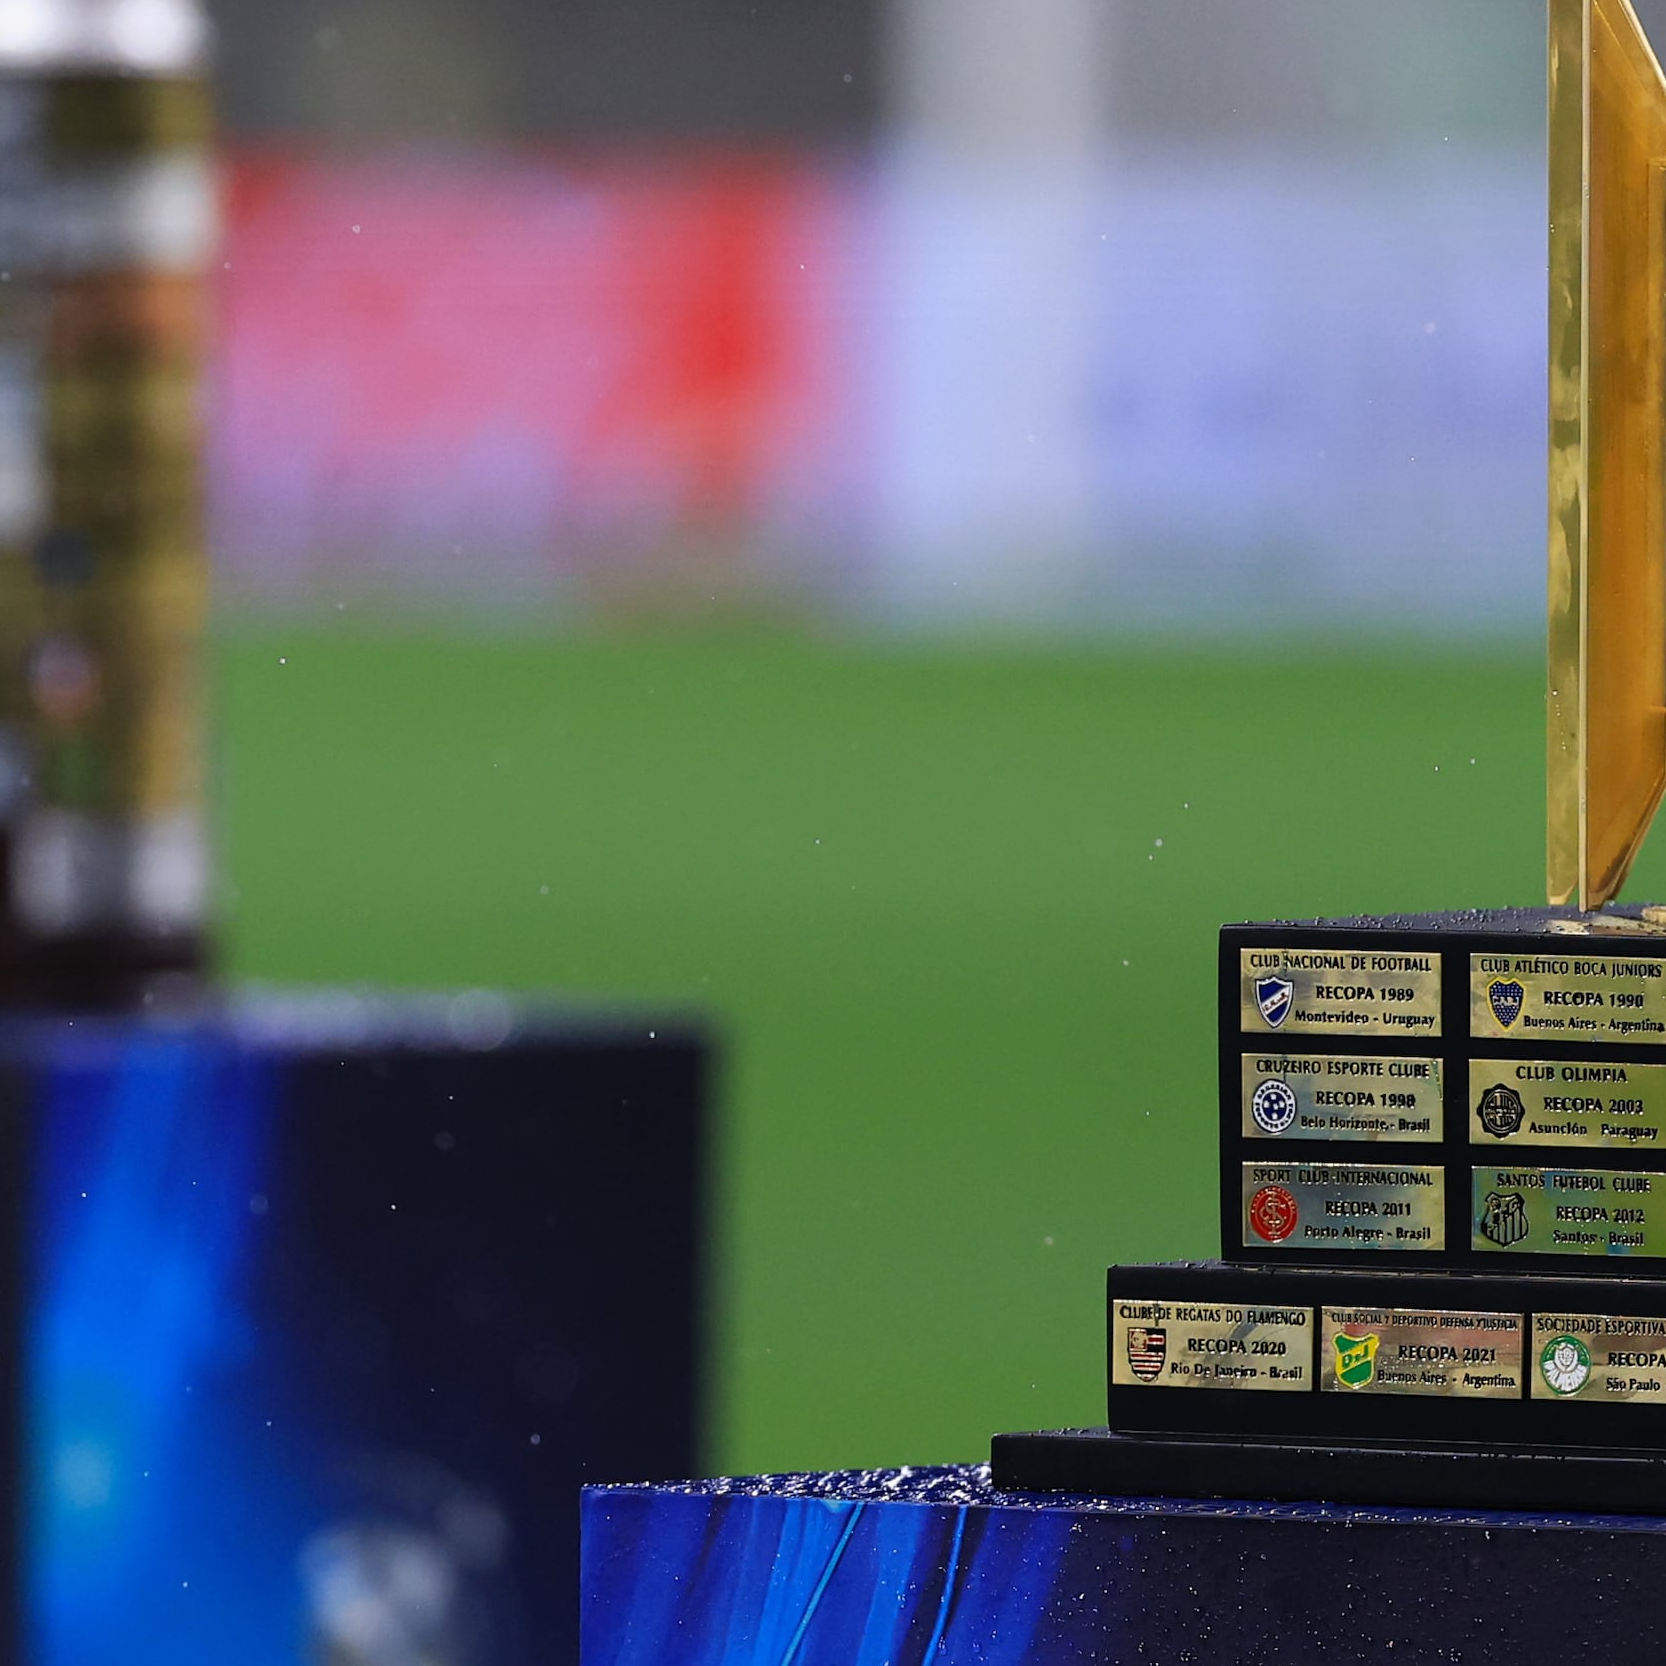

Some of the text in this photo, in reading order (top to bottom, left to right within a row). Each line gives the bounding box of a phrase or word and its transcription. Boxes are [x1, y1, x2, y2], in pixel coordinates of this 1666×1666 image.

[1251, 954, 1432, 972] CLUB NACIONAL DE FOOTBALL
[1481, 957, 1662, 978] CLUB ATLÉTICO BOCA JUNIORS
[1316, 986, 1414, 1001] RECOPA 1989
[1544, 991, 1644, 1008] RECOPA 1990
[1295, 1010, 1435, 1028] Montevideo Uruguay
[1524, 1016, 1665, 1034] Buenos Aires Argentina
[1257, 1060, 1430, 1077] CRUZEIRO ESPORTE CLUBE
[1516, 1066, 1628, 1082] CLUB OLIMPIA
[1316, 1091, 1415, 1108] RECOPA 1998
[1544, 1097, 1643, 1113] RECOPA 2003
[1301, 1116, 1430, 1131] Belo Horizonte Brasil
[1529, 1122, 1658, 1140] Asunción Paraguay
[1254, 1169, 1433, 1185] SPORT CLUB INTERNACIONAL
[1497, 1173, 1651, 1191] SANTOS FUTEBOL CLUBE
[1325, 1201, 1411, 1215] RECOPA 2011
[1557, 1206, 1644, 1223] RECOPA 2012
[1305, 1225, 1430, 1241] Porto Alegre Brasil
[1554, 1230, 1644, 1245] Santos Brasil
[1120, 1305, 1305, 1326] CLUBE DE REGATAS DO FLAMENGO
[1332, 1313, 1352, 1323] CLUB
[1354, 1314, 1382, 1324] SOCIAL
[1385, 1315, 1389, 1324] Y
[1393, 1316, 1437, 1326] DEPORTIVO
[1441, 1318, 1474, 1327] DEFENSA
[1477, 1319, 1482, 1328] Y
[1538, 1318, 1601, 1333] SOCIEDADE
[1606, 1320, 1665, 1335] ESPORTIVA
[1188, 1338, 1286, 1355] RECOPA 2020
[1398, 1345, 1496, 1362] RECOPA 2021
[1608, 1353, 1666, 1368] RECOPA
[1171, 1362, 1302, 1379] Rio De Janeiro Brasil
[1377, 1369, 1515, 1388] Buenos Aires Argentina
[1606, 1377, 1626, 1390] São
[1630, 1378, 1660, 1392] Paulo
